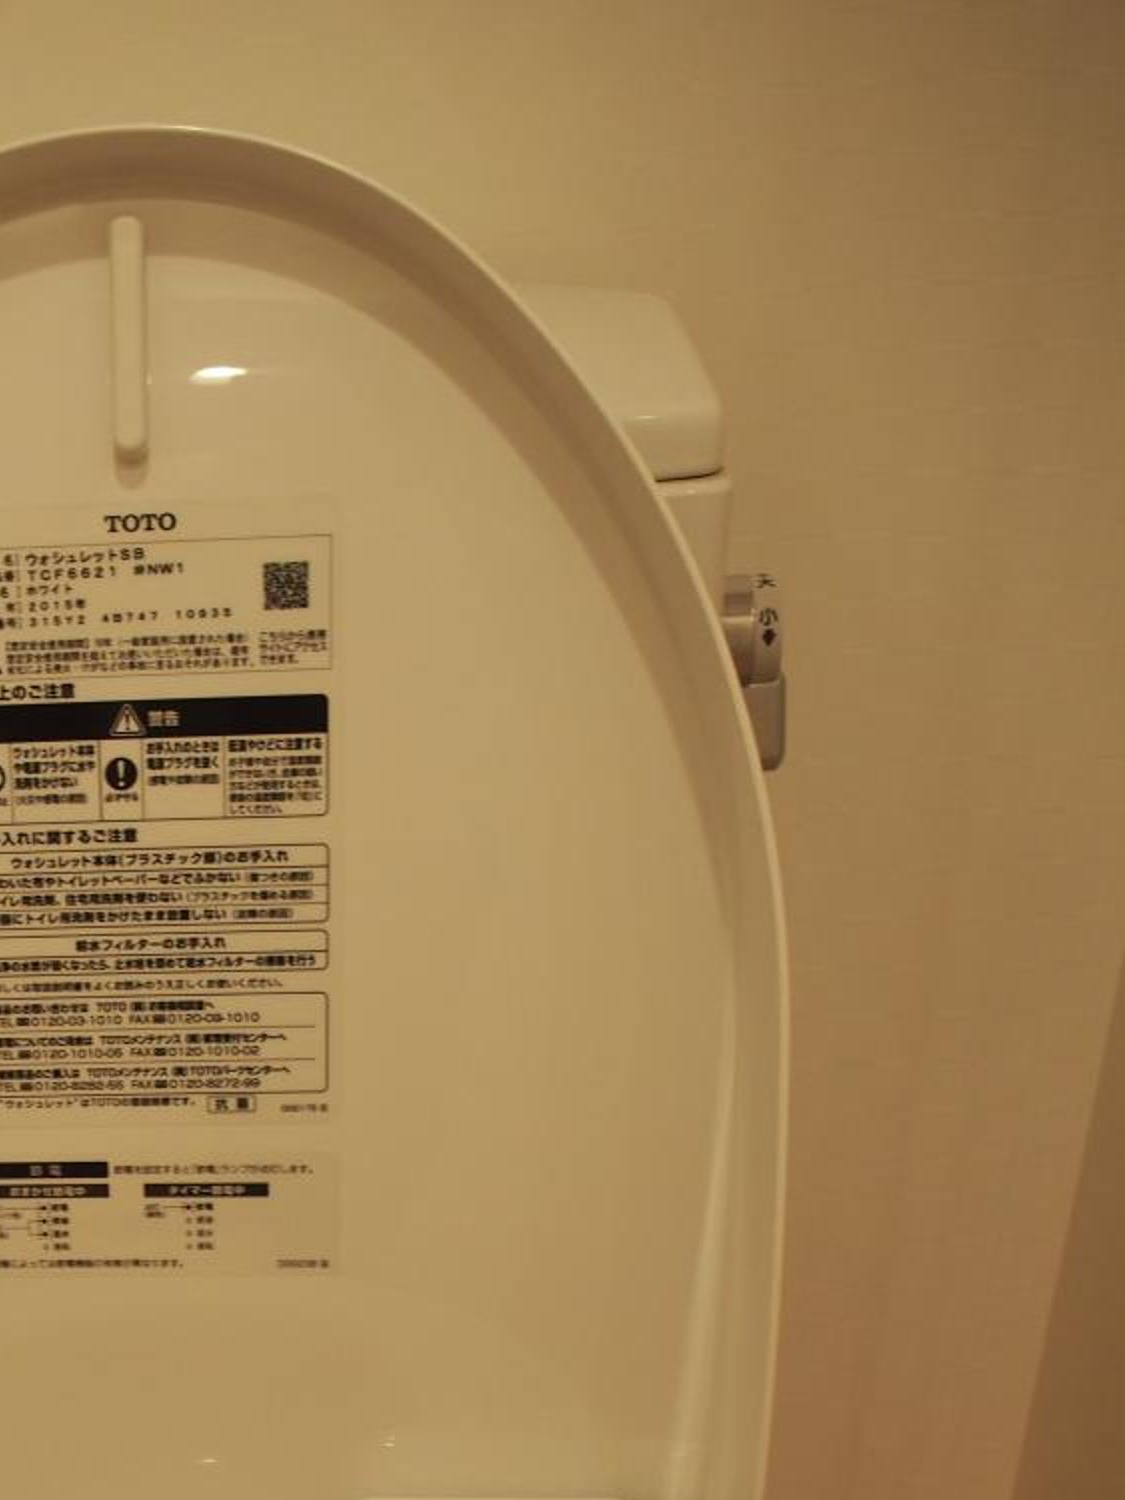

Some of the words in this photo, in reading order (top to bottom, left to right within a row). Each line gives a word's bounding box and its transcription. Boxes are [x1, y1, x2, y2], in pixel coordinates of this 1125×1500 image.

[104, 513, 176, 533] TOTO
[25, 548, 145, 566] ウォシュレットSB
[27, 566, 116, 581] TCF6621
